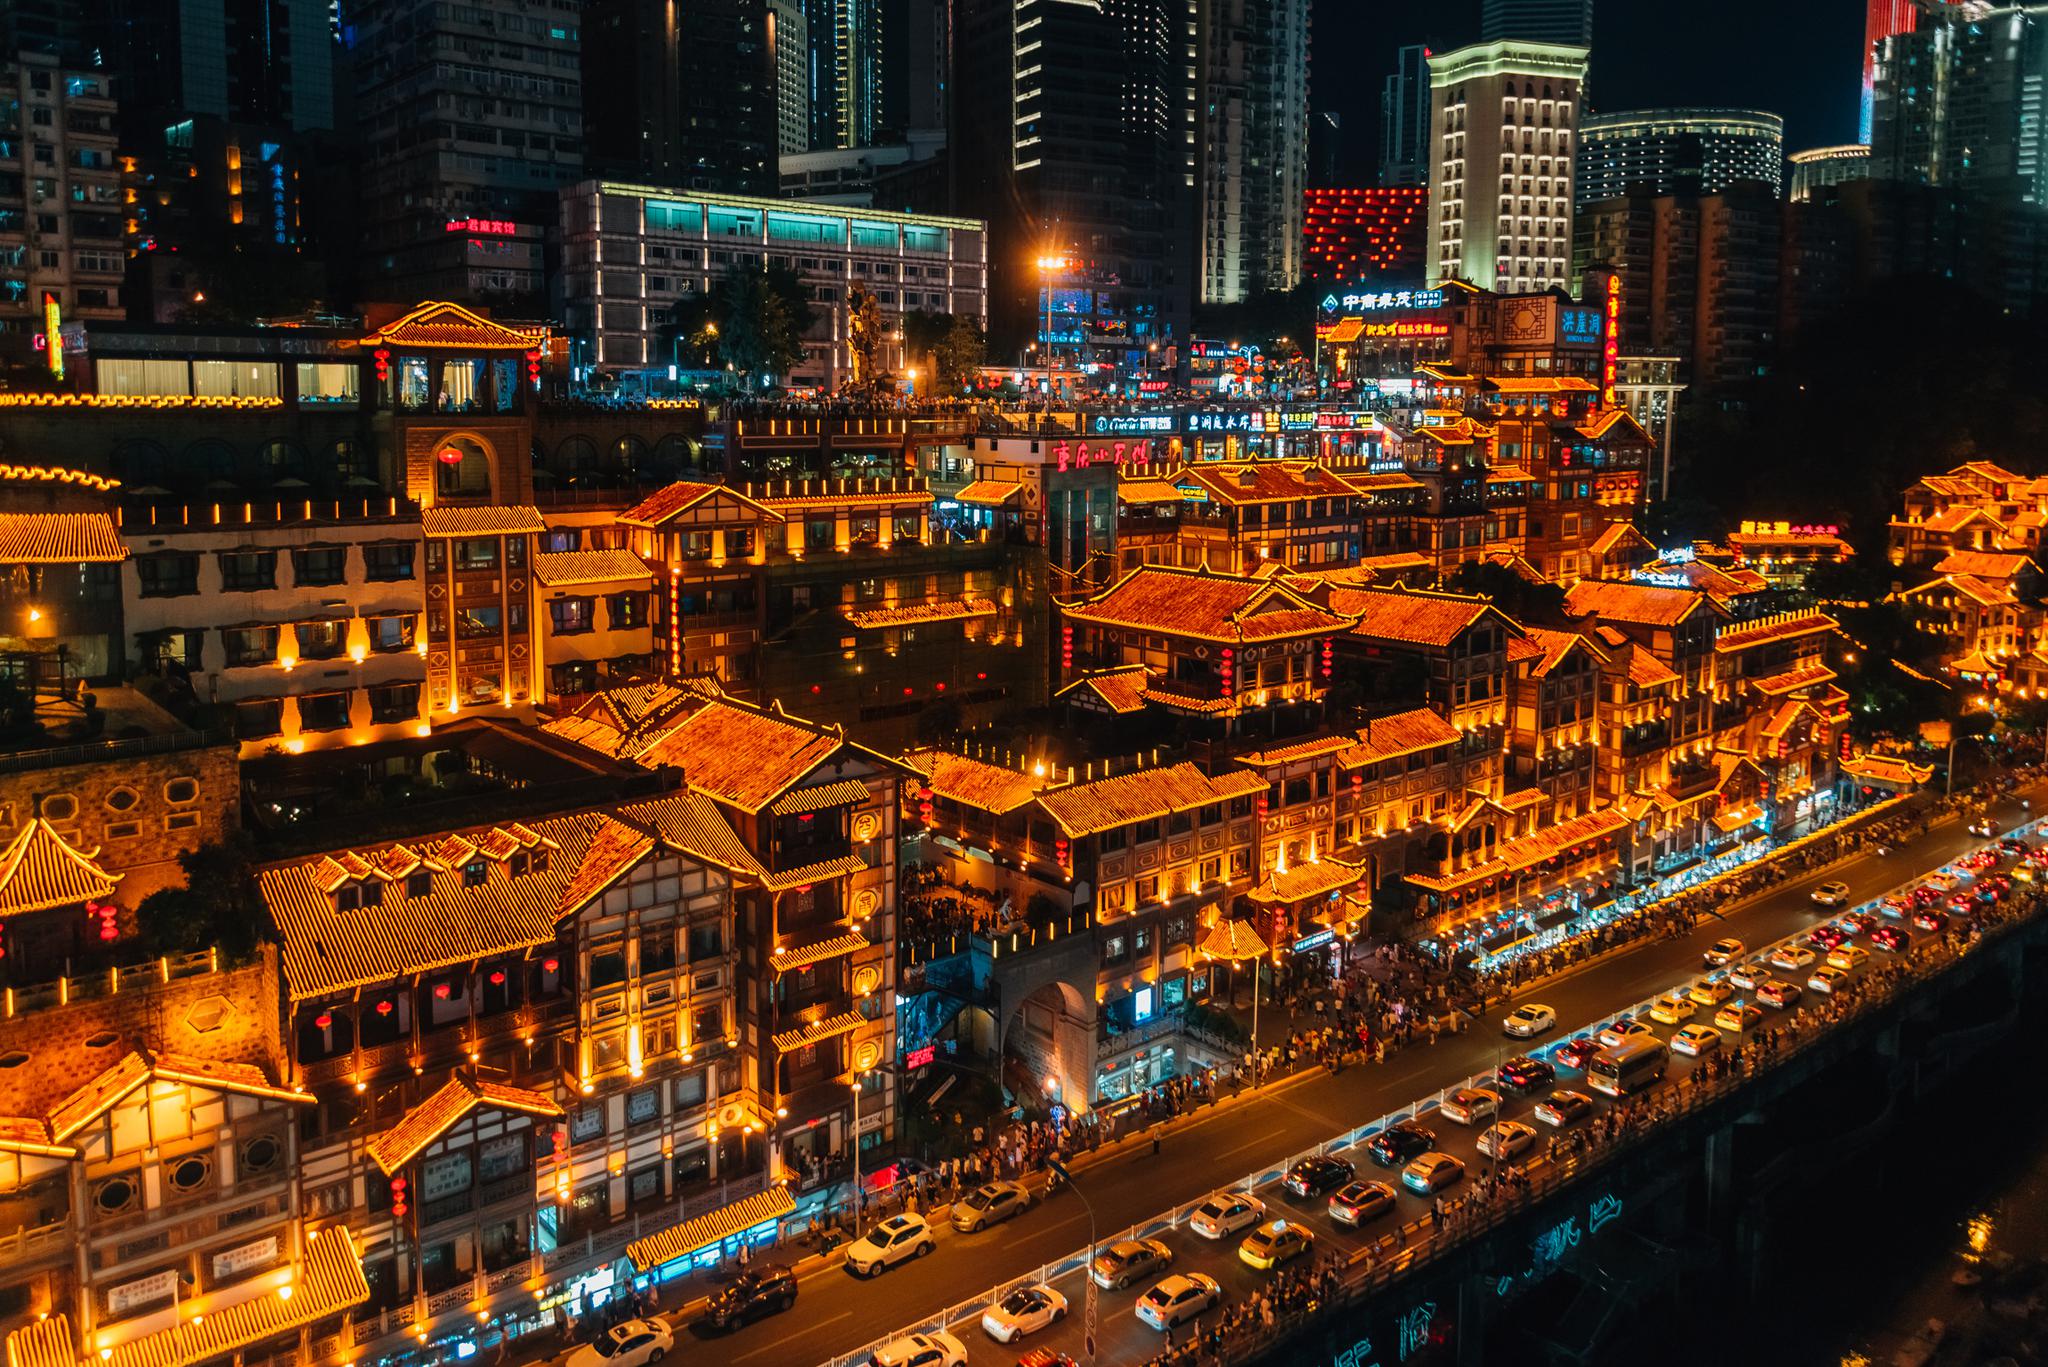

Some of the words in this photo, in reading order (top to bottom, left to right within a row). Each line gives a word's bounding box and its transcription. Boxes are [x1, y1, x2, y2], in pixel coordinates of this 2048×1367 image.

[1562, 310, 1600, 335] 洪崖洞
[1201, 414, 1250, 430] 洞庭水岸
